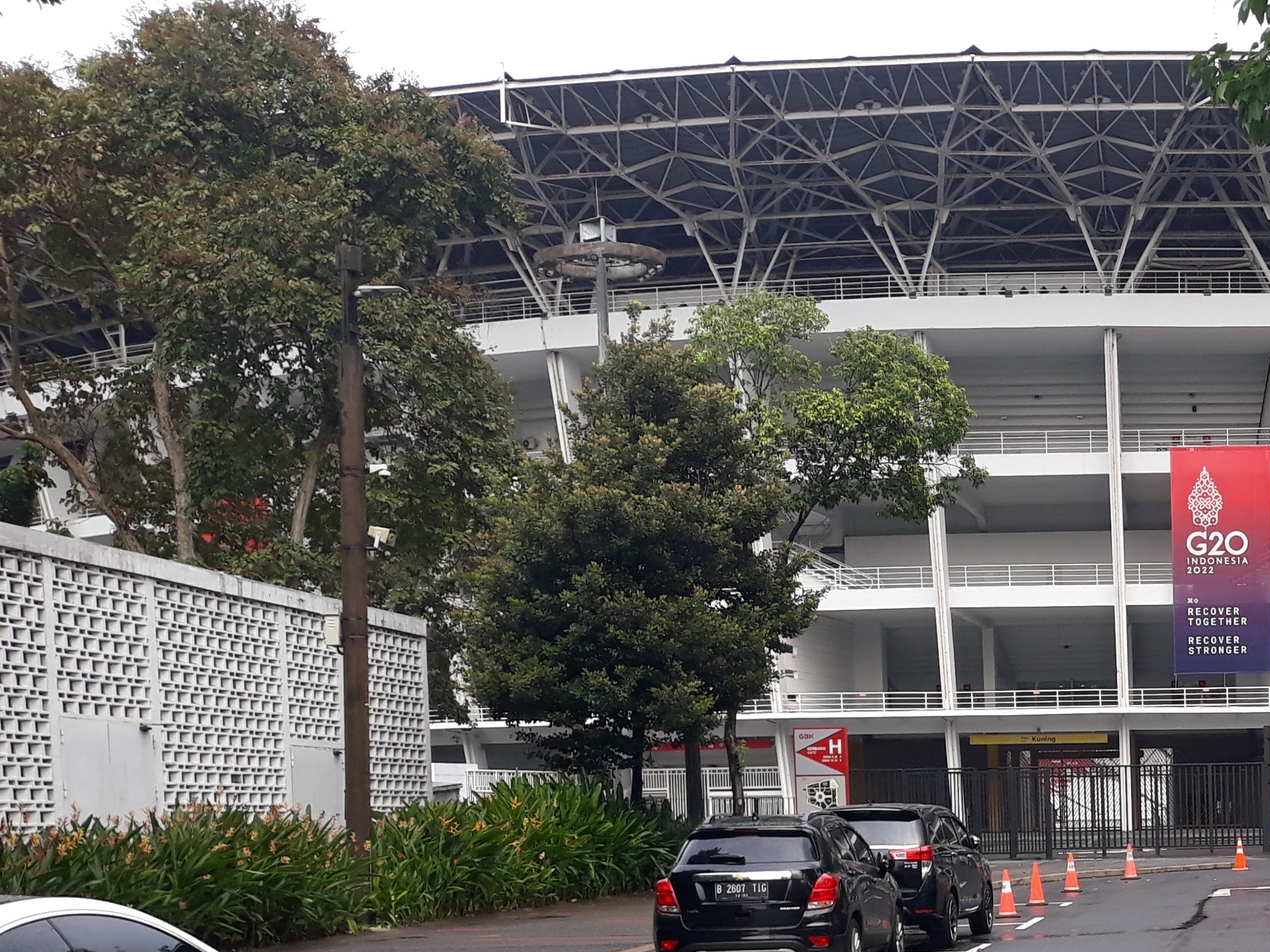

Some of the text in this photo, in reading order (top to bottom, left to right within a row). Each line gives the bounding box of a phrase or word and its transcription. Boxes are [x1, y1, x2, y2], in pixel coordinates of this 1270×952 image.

[1186, 530, 1249, 556] G20
[1186, 556, 1249, 565] INDONESIA
[1186, 566, 1215, 574] 2022
[1187, 606, 1240, 616] RECOVER
[1187, 616, 1248, 626] TOGETHER
[1188, 635, 1240, 645] RECOVER
[1188, 645, 1248, 655] STRONGER
[1031, 735, 1057, 743] Kuning
[829, 738, 842, 755] H
[716, 882, 767, 894] B 2607 TIG
